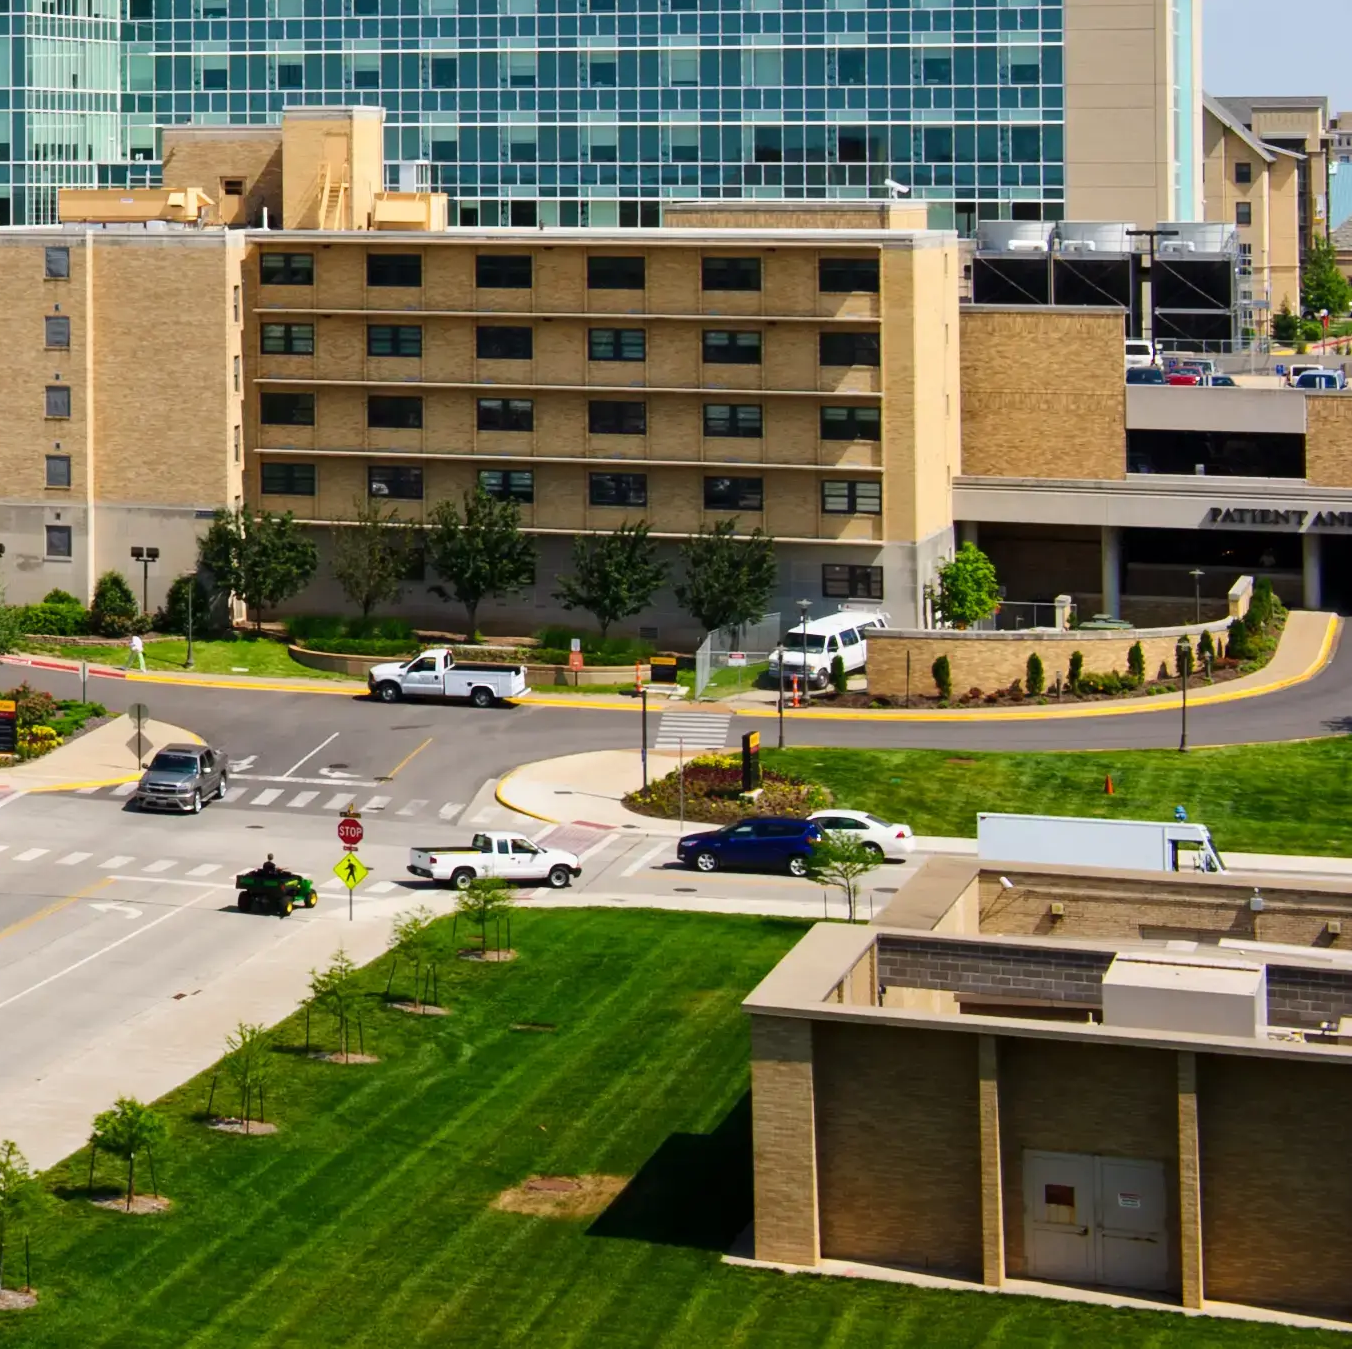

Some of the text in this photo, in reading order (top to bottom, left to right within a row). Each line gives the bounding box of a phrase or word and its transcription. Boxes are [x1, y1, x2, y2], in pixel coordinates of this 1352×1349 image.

[1209, 507, 1352, 528] PATIENT AN
[339, 826, 363, 838] STOP
